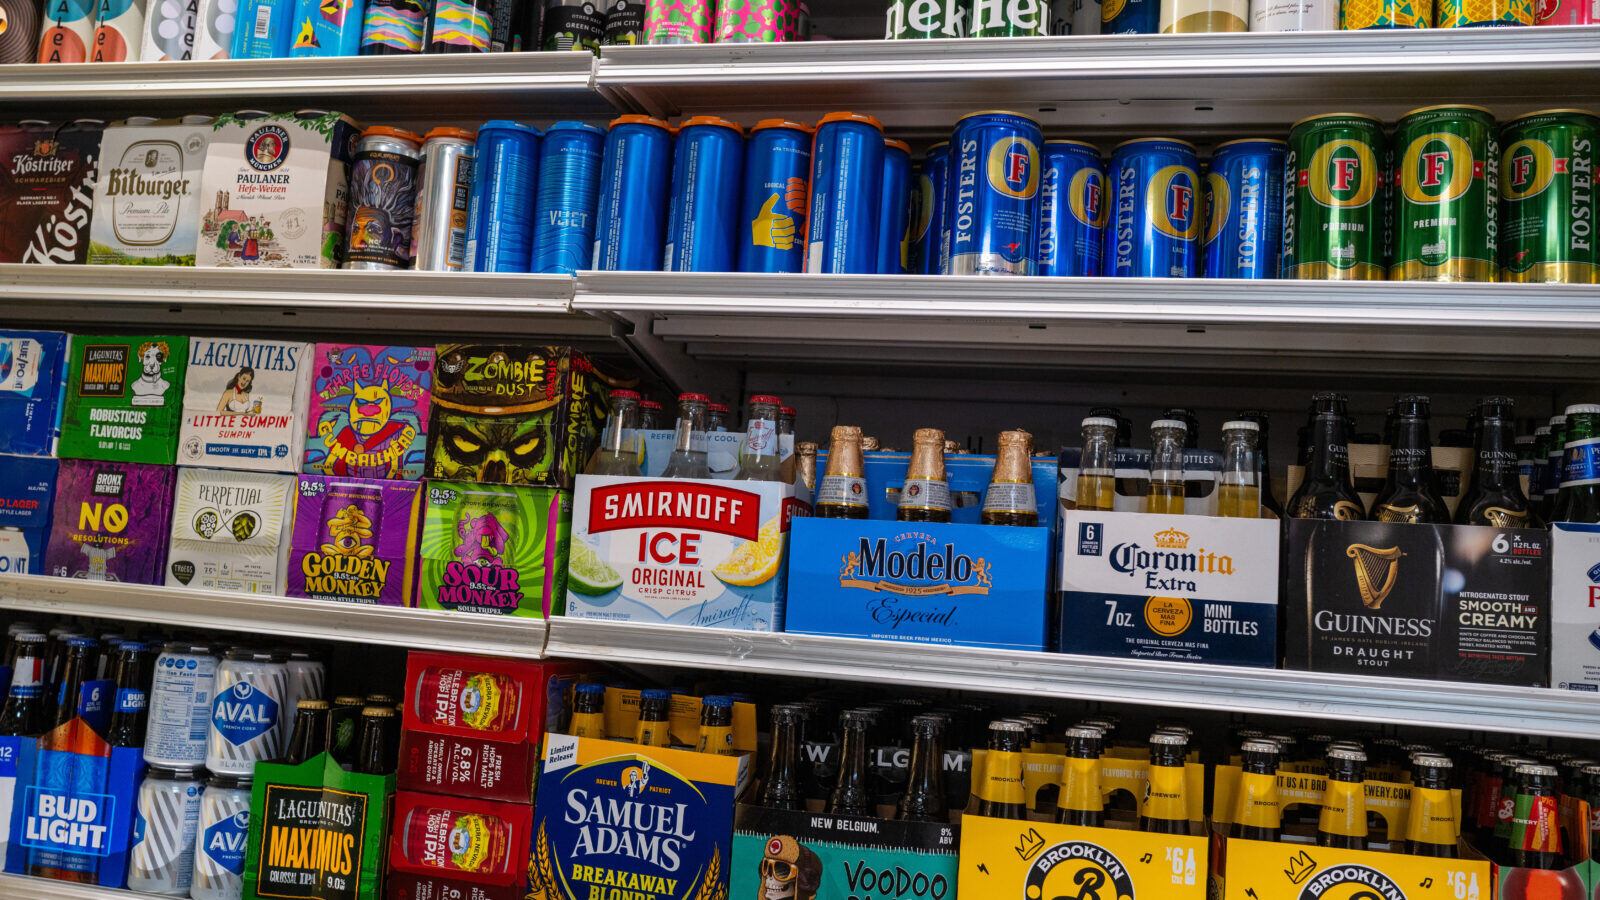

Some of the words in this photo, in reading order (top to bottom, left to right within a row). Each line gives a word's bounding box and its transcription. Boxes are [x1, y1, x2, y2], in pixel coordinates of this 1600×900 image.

[566, 22, 589, 31] GREEN
[249, 124, 289, 143] PAULANER
[11, 153, 74, 175] Köstritzer
[1007, 152, 1028, 183] F
[1332, 158, 1358, 190] F
[1422, 151, 1449, 186] F
[1512, 154, 1533, 186] F
[105, 168, 190, 200] Bitburger
[236, 174, 290, 185] PAULANER
[238, 184, 287, 196] Hefe-Weizen
[956, 138, 977, 244] FOSTER'S
[1086, 183, 1101, 213] F
[1486, 134, 1499, 251] FOSTER'S
[1571, 135, 1592, 251] FOSTER'S
[1170, 185, 1192, 221] F
[1039, 167, 1059, 266] FOSTER'S
[1116, 166, 1136, 269] FOSTER'S
[1237, 164, 1261, 270] FOSTER'S
[1322, 222, 1365, 232] PREMIUM
[1413, 218, 1457, 229] PREMIUM
[89, 350, 124, 361] LAGUNITAS
[190, 341, 298, 372] LAGUNITAS
[84, 363, 124, 385] MAXIMUS
[464, 356, 546, 382] ZOMBIE
[325, 365, 370, 396] THREE
[375, 363, 423, 401] FLOYDS
[496, 383, 537, 398] DUST
[90, 408, 147, 425] ROBUSTICUS
[193, 415, 237, 428] LITTLE
[240, 416, 293, 428] SUMPIN'
[90, 424, 143, 440] FLAVORCUS
[318, 417, 416, 467] GUMBALLHEAD
[714, 435, 738, 443] COOL
[95, 485, 121, 494] BREWERY
[97, 473, 123, 486] BRONX
[300, 480, 325, 492] 9.5%
[6, 499, 38, 509] LAGER
[199, 484, 263, 507] PERPETUAL
[430, 488, 457, 500] 9.5%
[78, 501, 129, 533] NO
[605, 491, 743, 524] SMIRNOFF
[72, 534, 129, 545] RESOLUTIONS
[894, 531, 937, 545] CERVEZA
[1086, 525, 1095, 540] 6
[1491, 533, 1510, 553] 6
[638, 531, 702, 565] ICE
[1513, 548, 1541, 556] BOTTLES
[302, 552, 391, 584] GOLDEN
[858, 537, 973, 582] Modelo
[1109, 542, 1234, 577] Coronita
[304, 574, 386, 597] MONKEY
[443, 561, 520, 591] SOUR
[632, 567, 705, 588] ORIGINAL
[1145, 570, 1197, 592] Extra
[438, 585, 524, 608] MONKEY
[638, 587, 663, 595] CRISP
[666, 588, 697, 596] CITRUS
[1459, 591, 1508, 600] NITROGENATED
[691, 593, 754, 627] Smirnoff
[866, 597, 957, 629] Especial
[1152, 607, 1184, 616] CERVEZA
[1160, 613, 1176, 621] MAS
[1204, 604, 1232, 619] MINI
[1459, 600, 1522, 614] SMOOTH
[1159, 619, 1175, 627] FINA
[1203, 619, 1259, 636] BOTTLES
[1314, 610, 1432, 637] GUINNESS
[1459, 612, 1538, 629] CREAMY
[1136, 638, 1160, 646] ORIGINAL
[1333, 645, 1414, 660] DRAUGHT
[1357, 659, 1390, 667] STOUT
[91, 687, 100, 700] 6
[438, 674, 448, 693] HOP
[127, 693, 145, 701] BUD
[435, 693, 449, 721] IPA
[448, 669, 463, 727] CELEBRATION
[214, 701, 271, 724] AVAL
[482, 744, 490, 766] RICH
[488, 747, 496, 768] HOPS
[549, 743, 575, 755] Limited
[549, 752, 574, 764] Release
[459, 746, 472, 782] 6.8%
[494, 755, 502, 781] FRESH
[595, 778, 618, 786] BREWER
[649, 785, 671, 795] PATRIOT
[1286, 776, 1297, 788] US
[1299, 777, 1310, 789] AT
[38, 794, 97, 823] BUD
[278, 799, 352, 827] LAGUNITAS
[564, 788, 696, 842] SAMUEL
[26, 816, 107, 848] LIGHT
[427, 814, 435, 833] HOP
[473, 818, 482, 841] SIERRA
[810, 817, 833, 829] NEW
[836, 819, 880, 834] BELGIUM.
[940, 827, 953, 836] 9%
[424, 833, 438, 861] IPA
[437, 810, 451, 867] CELEBRATION
[570, 825, 681, 872] ADAMS
[939, 836, 953, 845] ABV
[268, 825, 354, 886] MAXIMUS
[1037, 844, 1126, 881] BROOKLYN
[269, 870, 297, 884] COLOSSAL
[299, 872, 316, 885] IPA
[571, 864, 678, 897] BREAKAWAY
[844, 859, 949, 900] VOODOO
